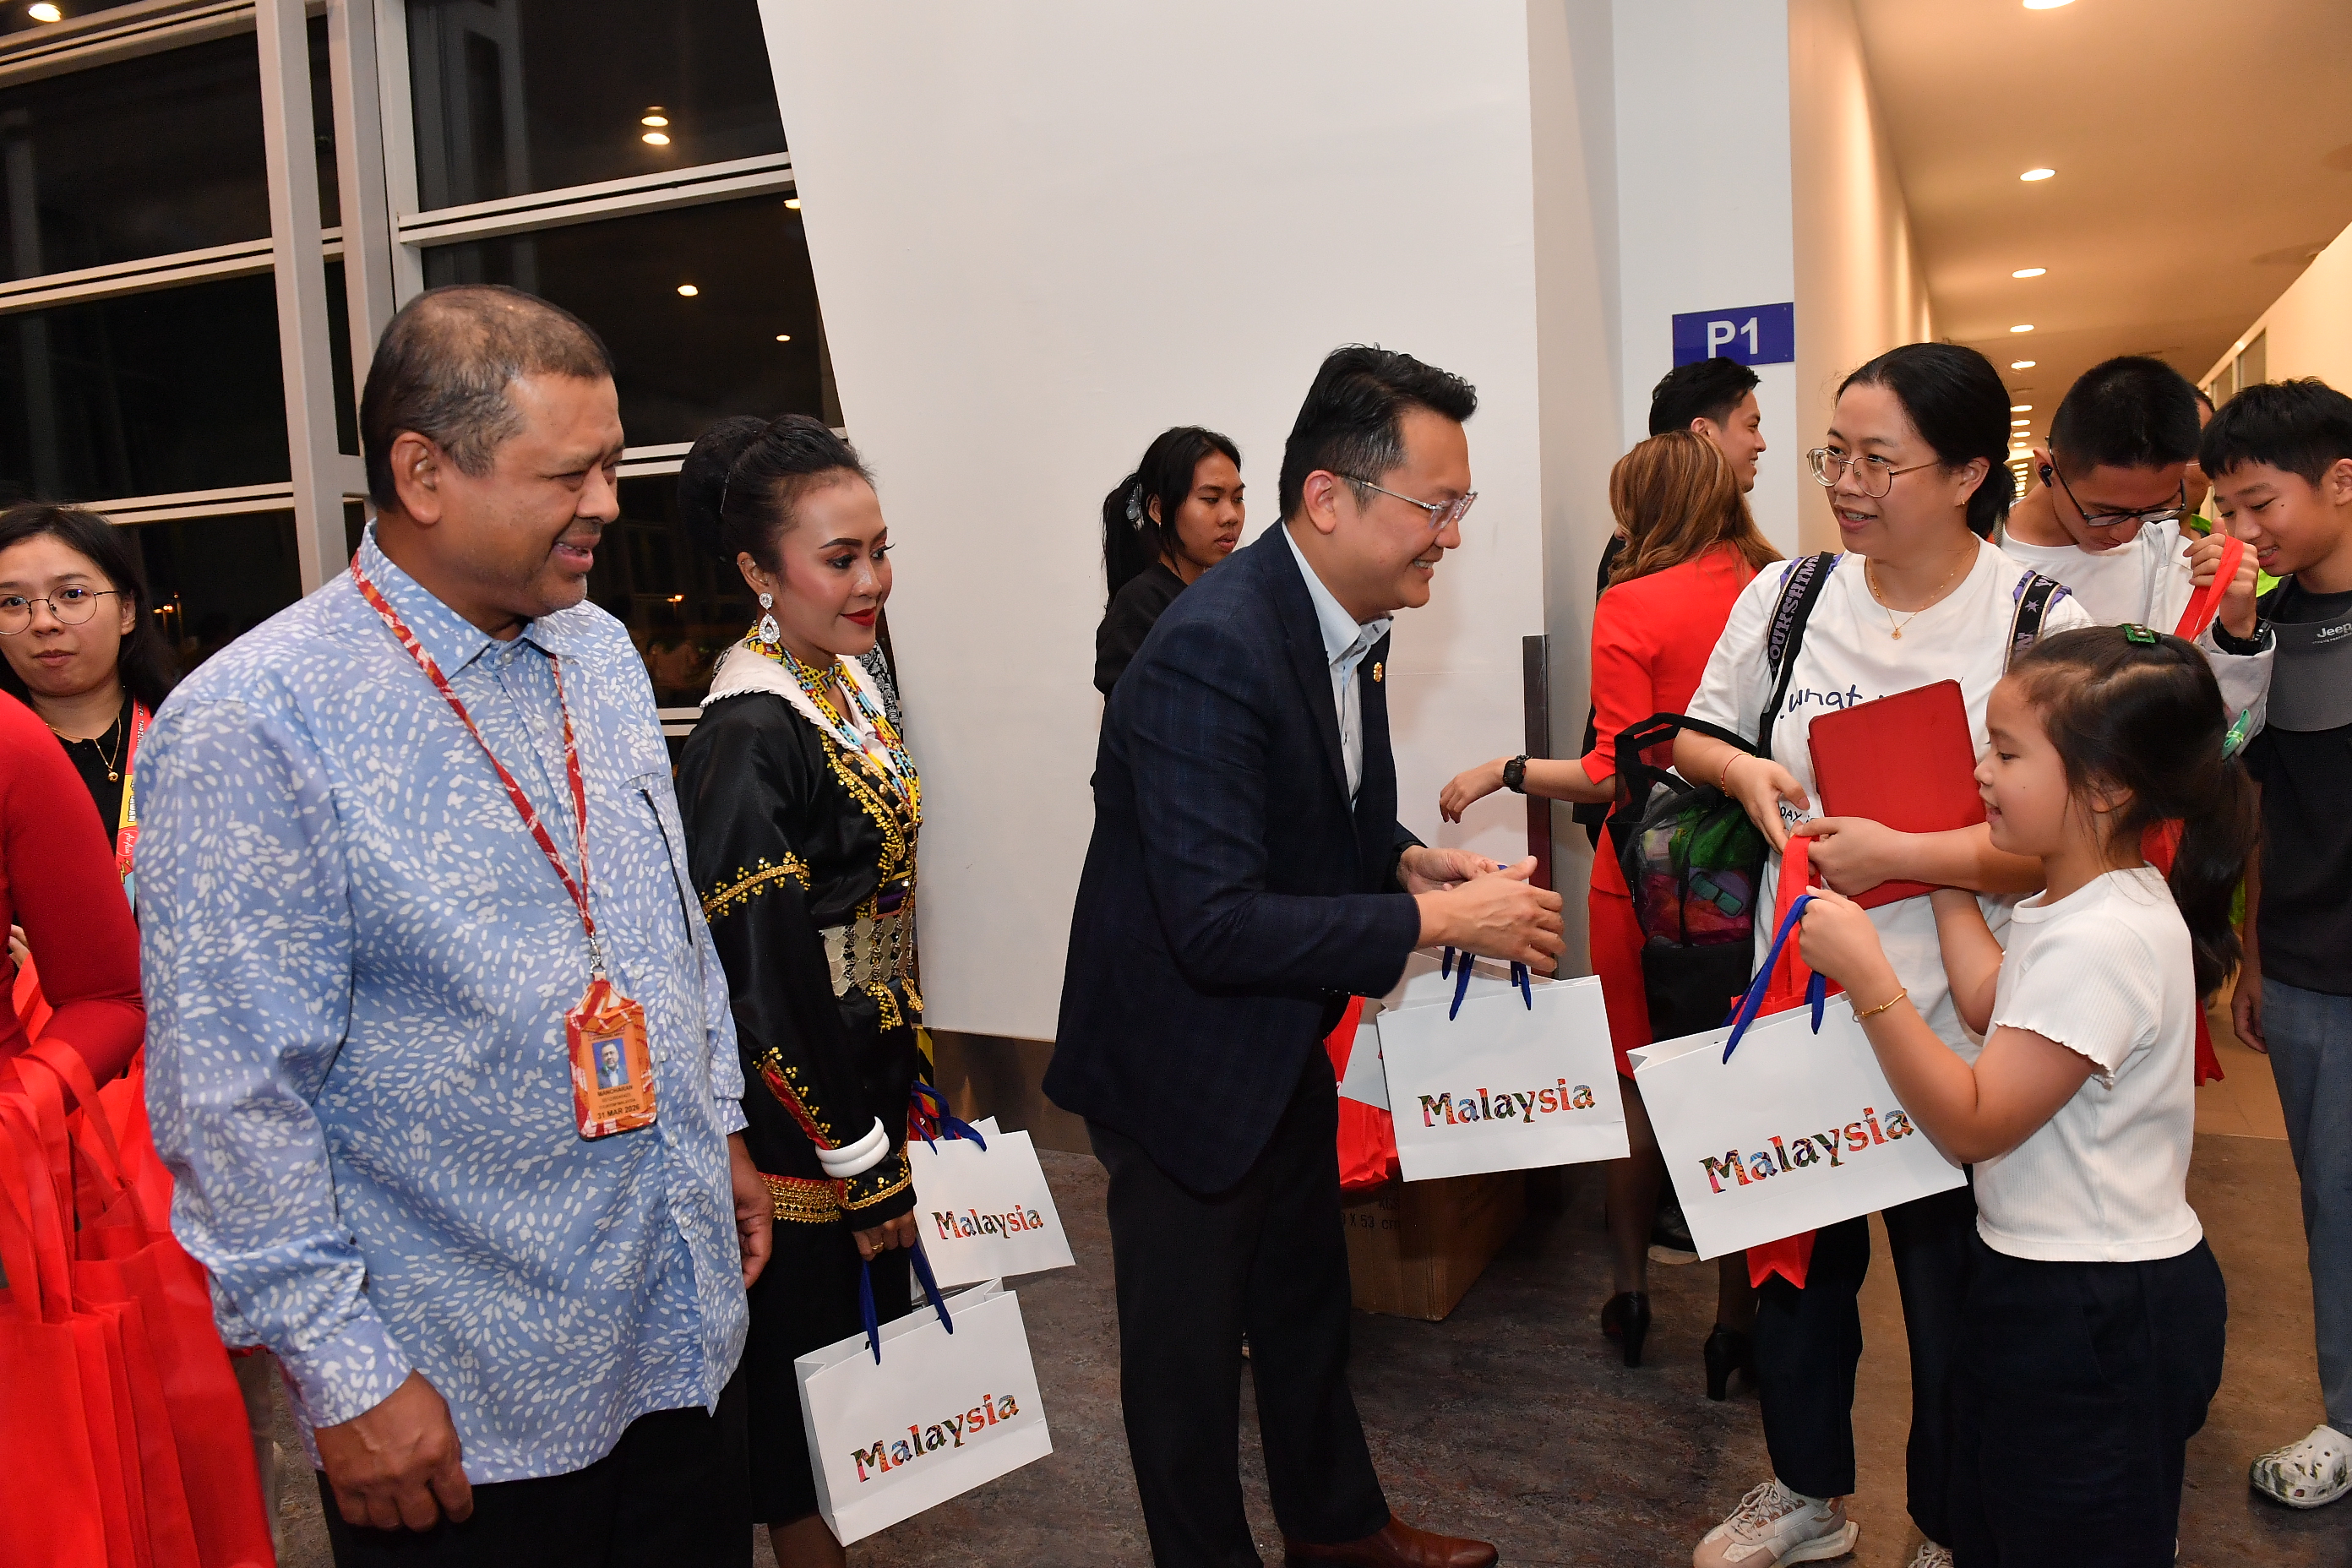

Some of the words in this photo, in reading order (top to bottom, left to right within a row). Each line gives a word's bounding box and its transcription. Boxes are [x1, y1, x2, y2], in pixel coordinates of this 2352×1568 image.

[1707, 317, 1758, 358] P1
[2317, 623, 2352, 637] Jeep
[607, 1108, 623, 1117] MAR
[625, 1103, 640, 1113] 2026
[1418, 1078, 1595, 1127] Malaysia
[1699, 1107, 1914, 1194] Malaysia
[931, 1204, 1044, 1240] Malaysia
[851, 1393, 1020, 1483] Malaysia
